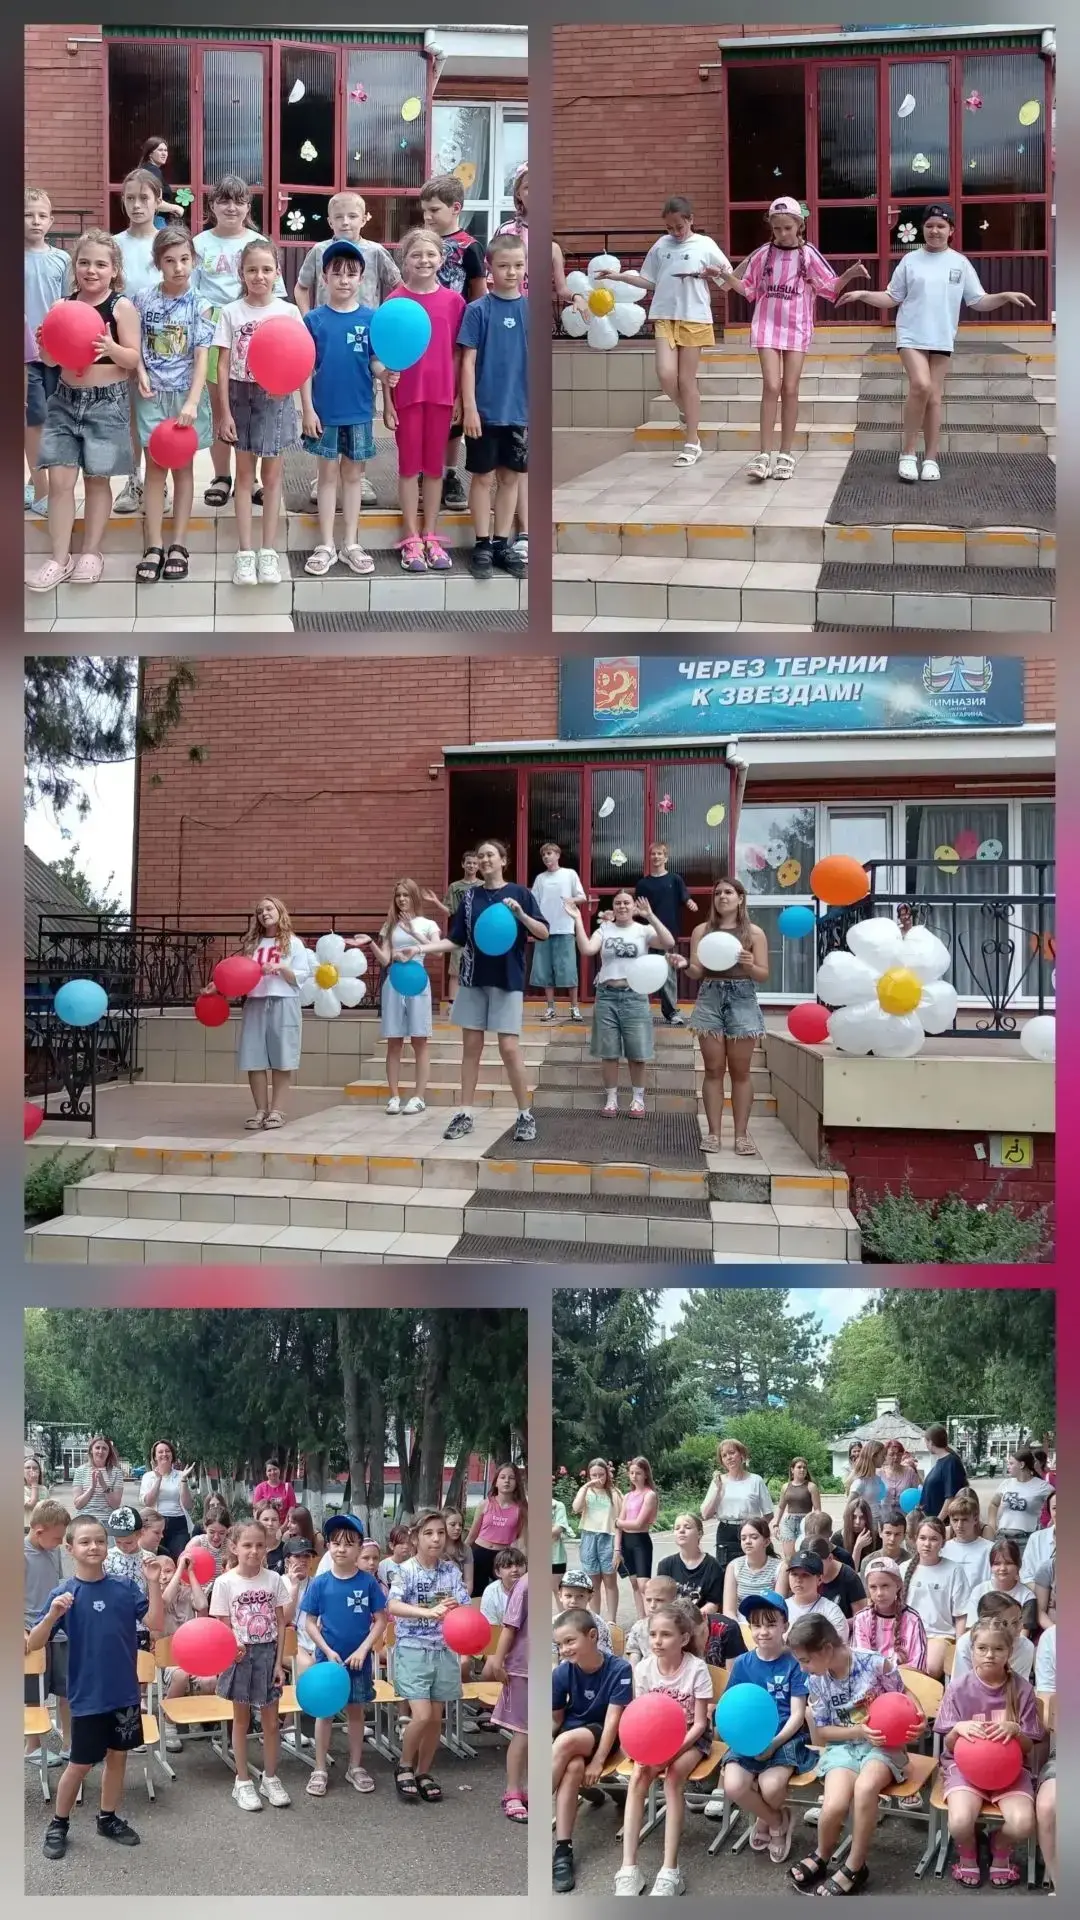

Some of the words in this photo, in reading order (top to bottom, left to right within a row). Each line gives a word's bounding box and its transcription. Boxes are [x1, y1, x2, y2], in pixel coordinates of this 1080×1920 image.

[678, 659, 766, 680] ЧЕРЕЗ
[775, 656, 889, 677] ТЕРНИИ
[691, 687, 713, 707] К
[718, 682, 864, 707] ЗВЕЗДАМ!
[929, 697, 987, 707] ГИМНАЗИЯ
